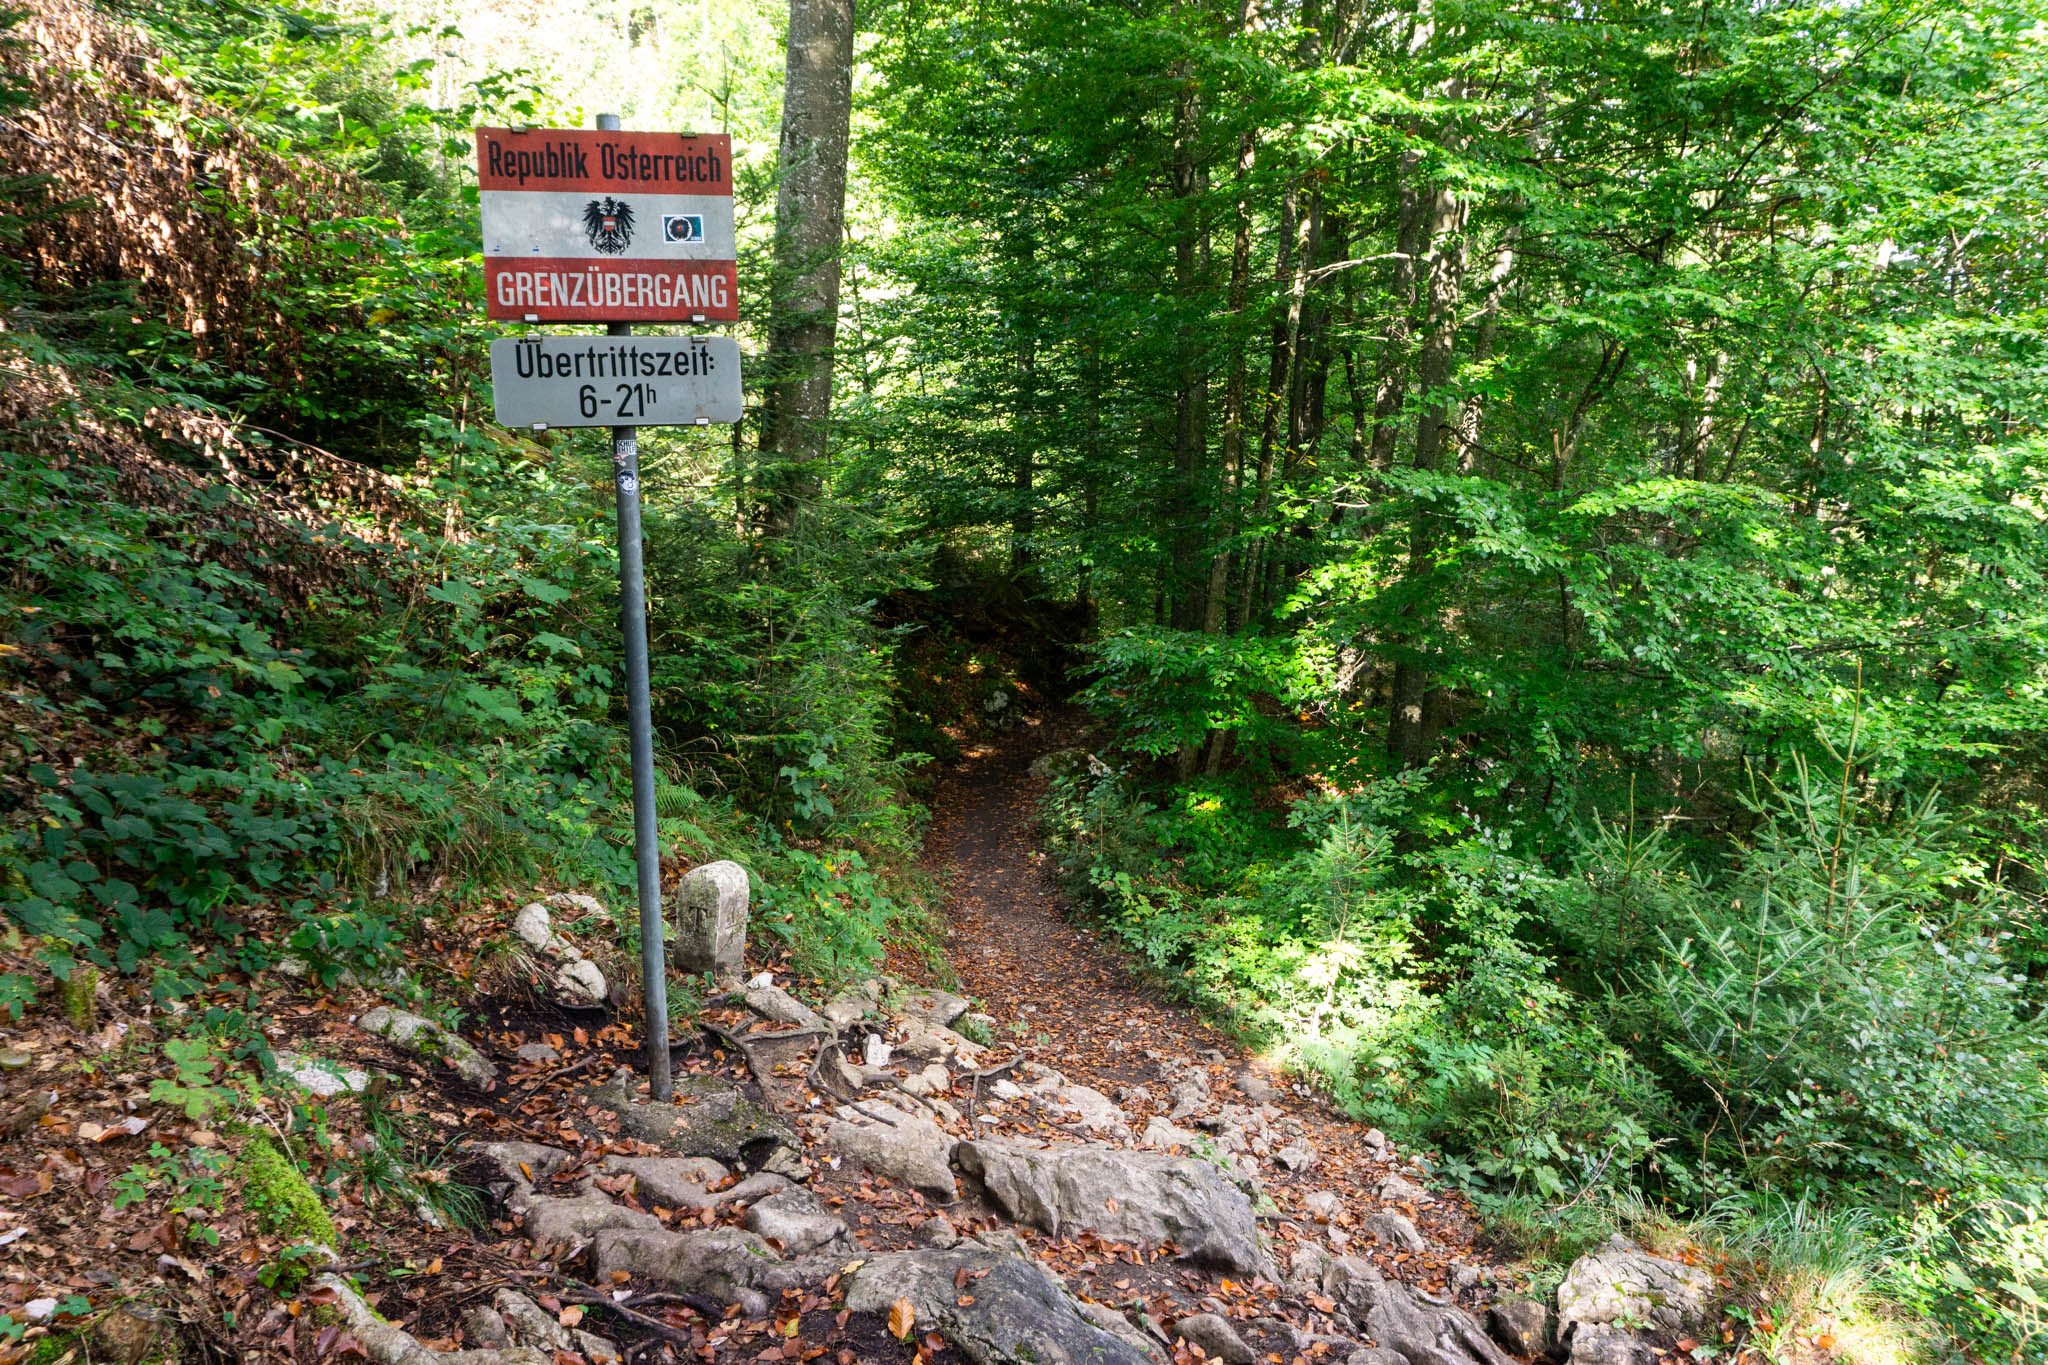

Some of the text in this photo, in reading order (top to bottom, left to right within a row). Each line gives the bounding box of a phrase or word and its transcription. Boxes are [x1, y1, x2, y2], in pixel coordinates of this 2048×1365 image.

[487, 140, 722, 185] Republik Österreich
[496, 266, 728, 308] GRENZÜBERGANG
[514, 339, 715, 379] Übertrittszeit:
